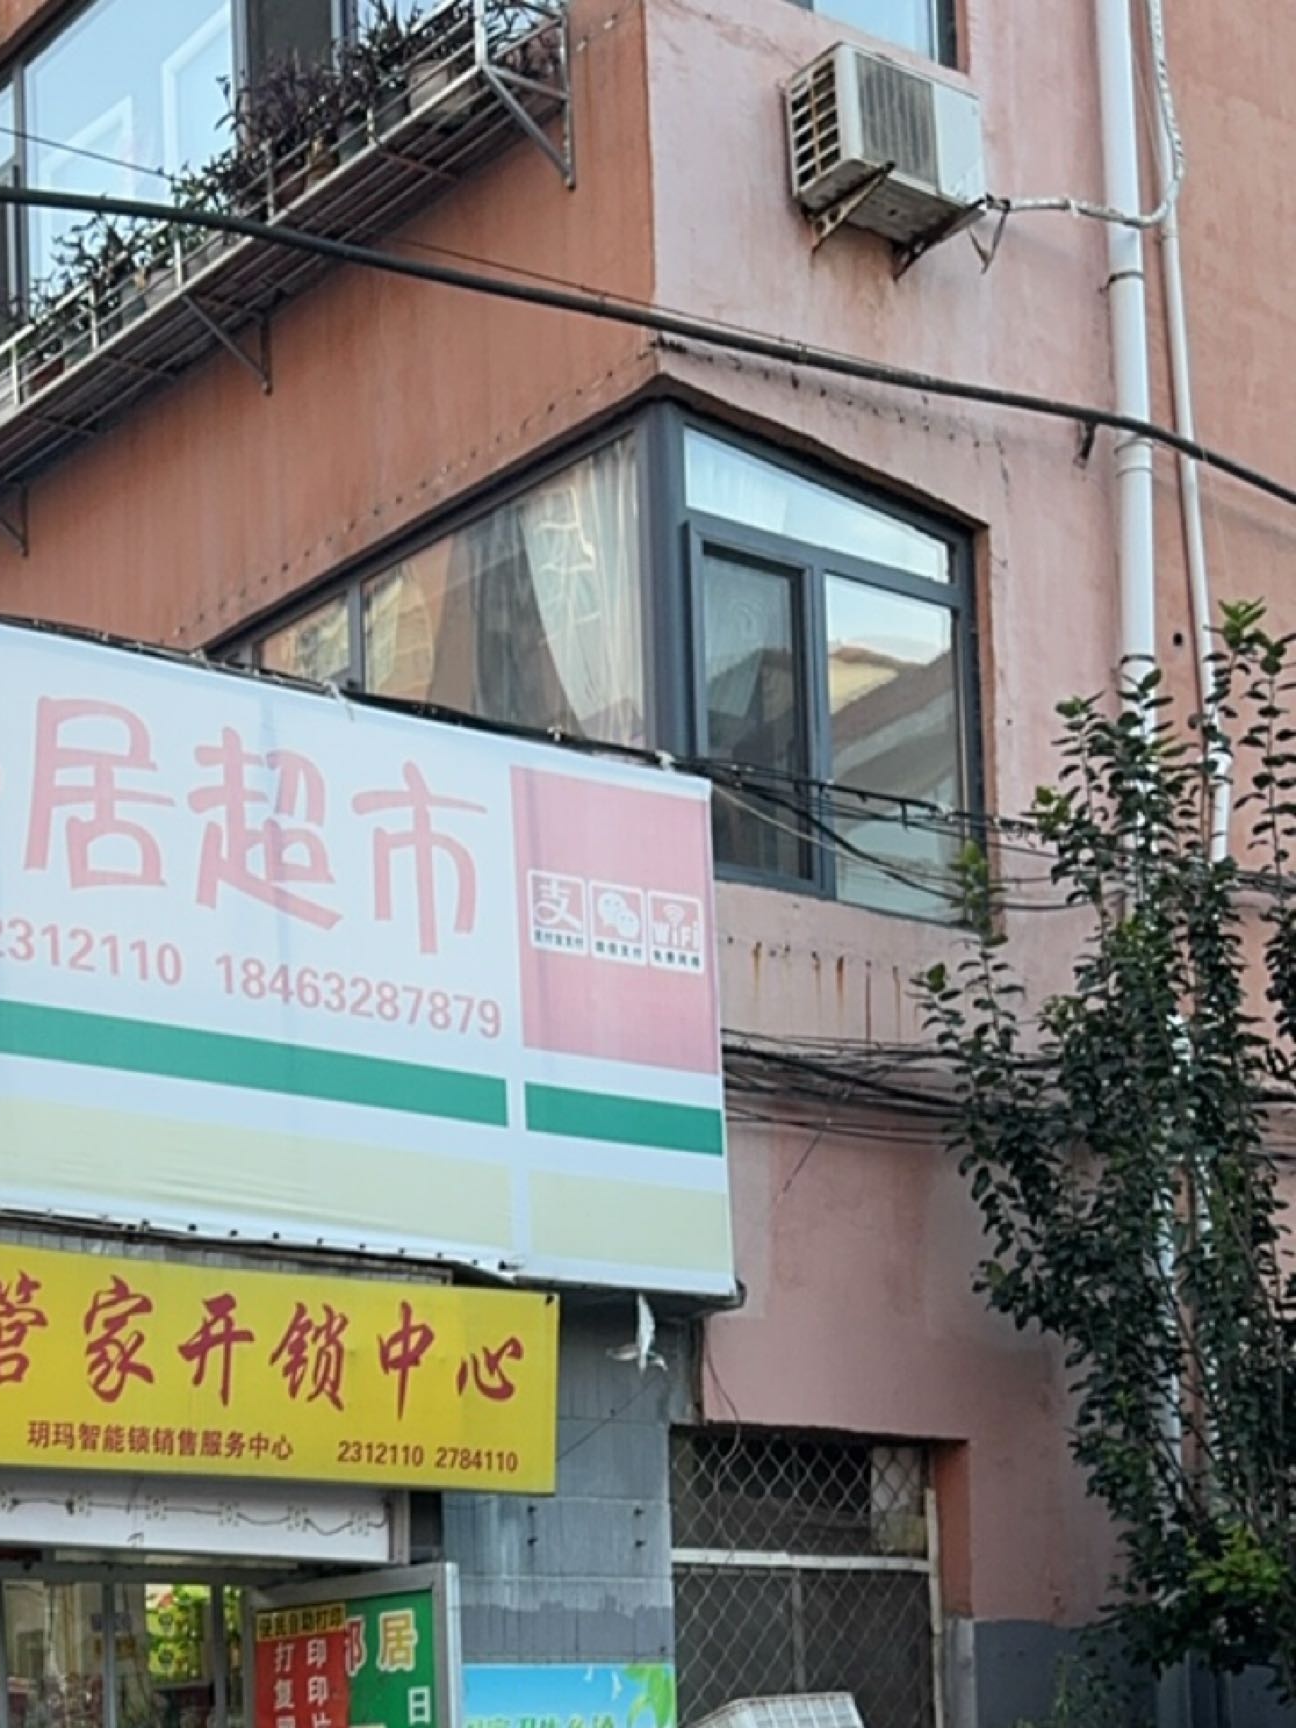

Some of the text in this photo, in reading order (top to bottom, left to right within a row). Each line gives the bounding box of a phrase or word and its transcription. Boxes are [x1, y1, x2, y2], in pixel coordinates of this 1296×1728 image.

[216, 954, 502, 1039] 18463287879
[28, 1420, 294, 1461] 玥玛智能锁销售服务中心
[337, 1440, 424, 1467] 2312110
[434, 1446, 519, 1472] 2784110
